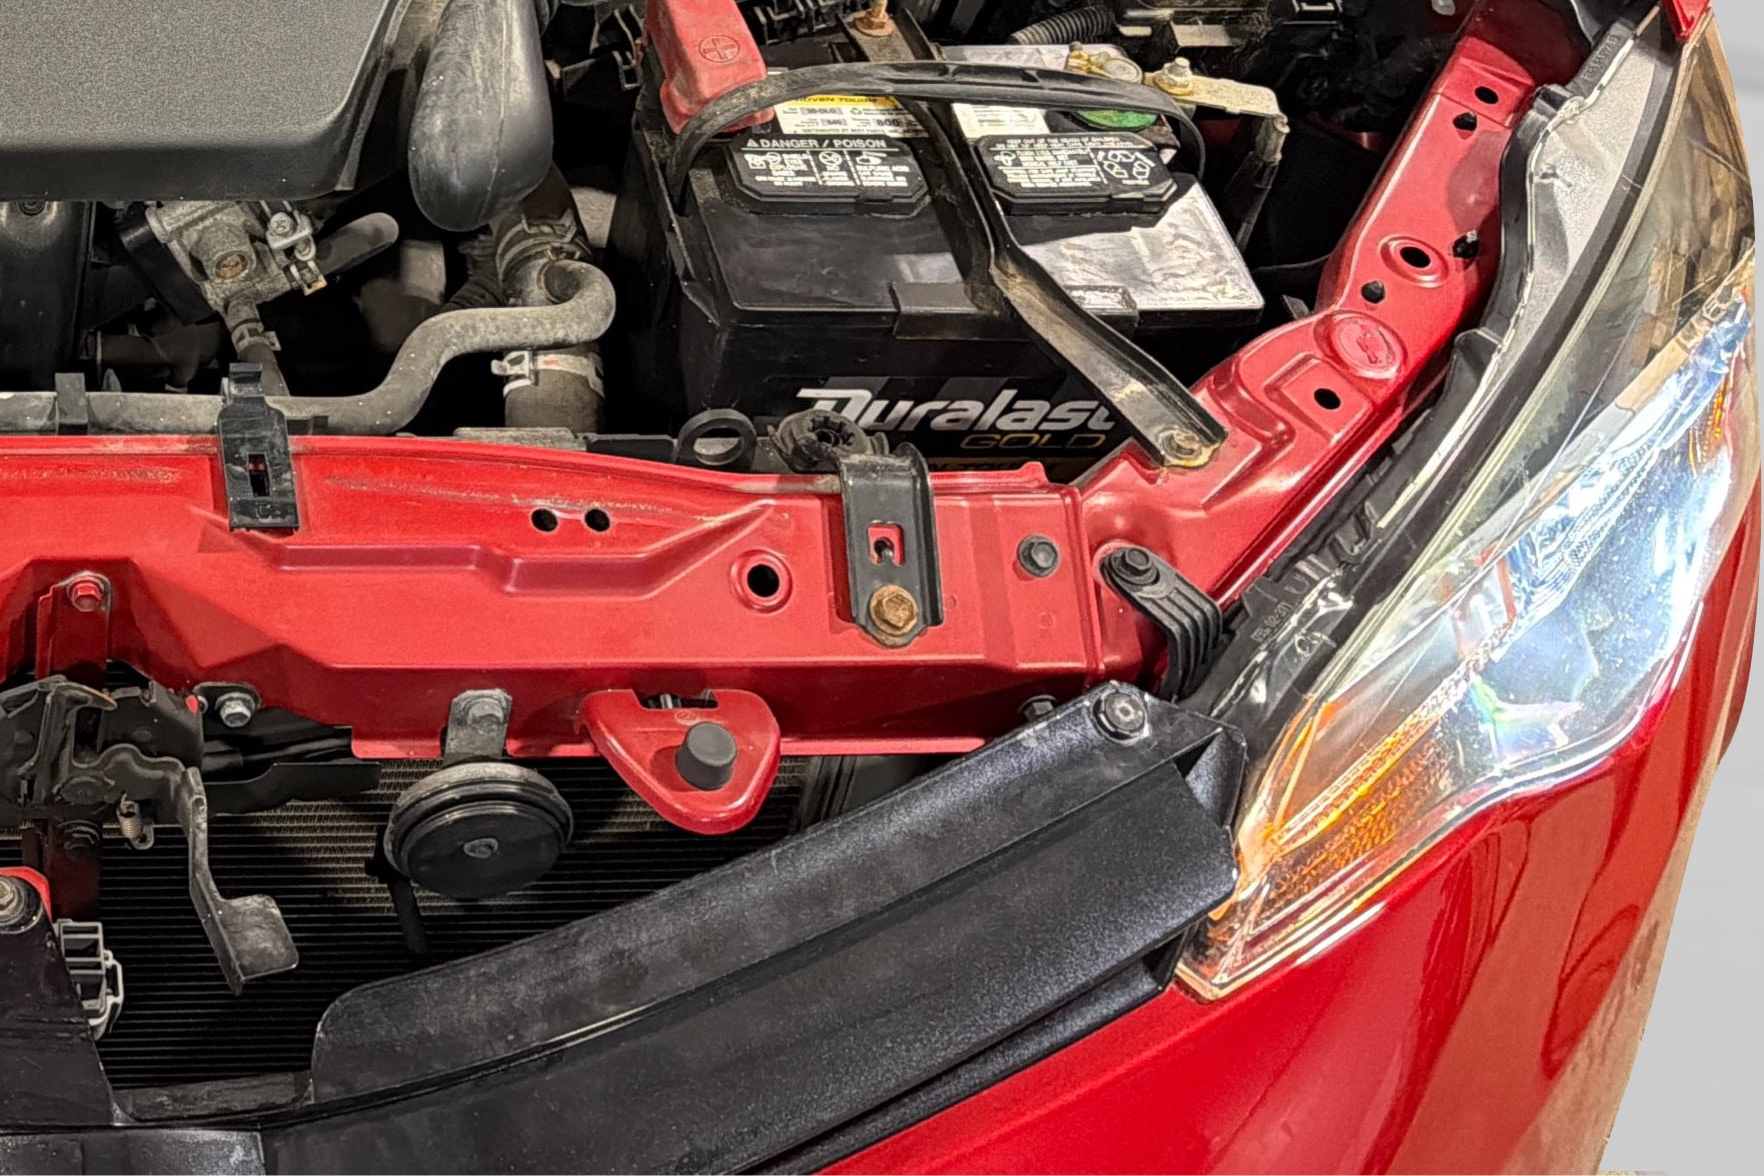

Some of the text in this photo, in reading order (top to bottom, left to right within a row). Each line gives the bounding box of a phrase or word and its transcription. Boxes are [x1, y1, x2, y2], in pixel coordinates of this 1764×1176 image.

[759, 139, 818, 148] DANGER
[833, 139, 886, 148] POISON
[959, 433, 1107, 449] GOLD
